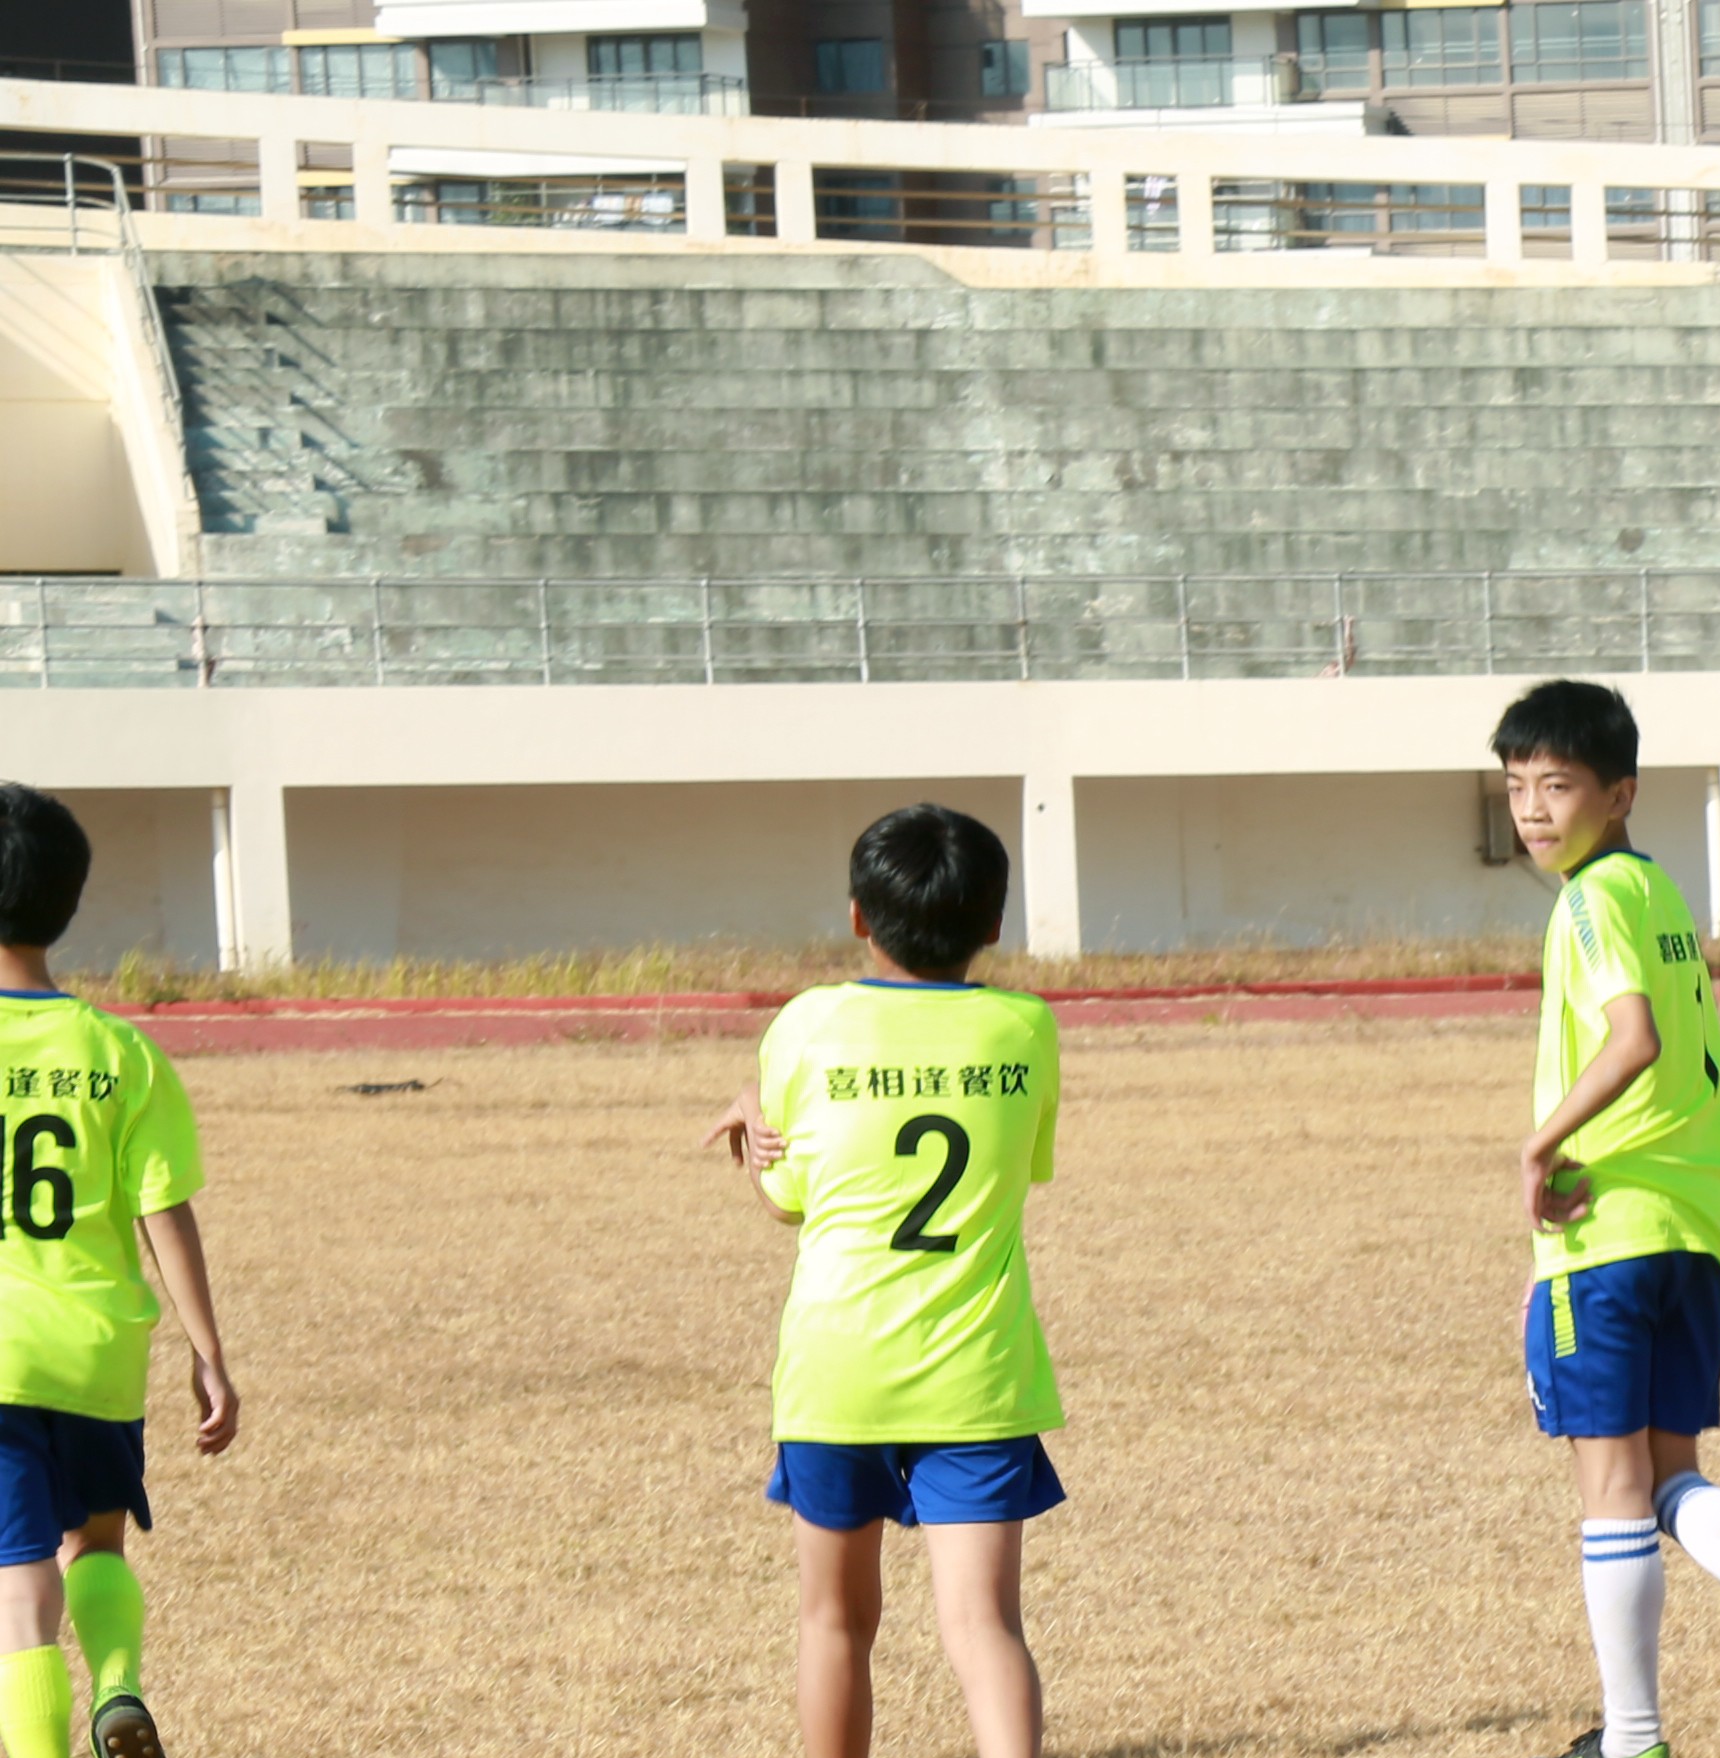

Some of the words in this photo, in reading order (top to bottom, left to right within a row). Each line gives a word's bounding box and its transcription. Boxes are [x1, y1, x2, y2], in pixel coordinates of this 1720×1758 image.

[825, 1062, 1030, 1100] 喜相逢餐饮
[0, 1113, 76, 1240] 6
[890, 1113, 970, 1253] 2
